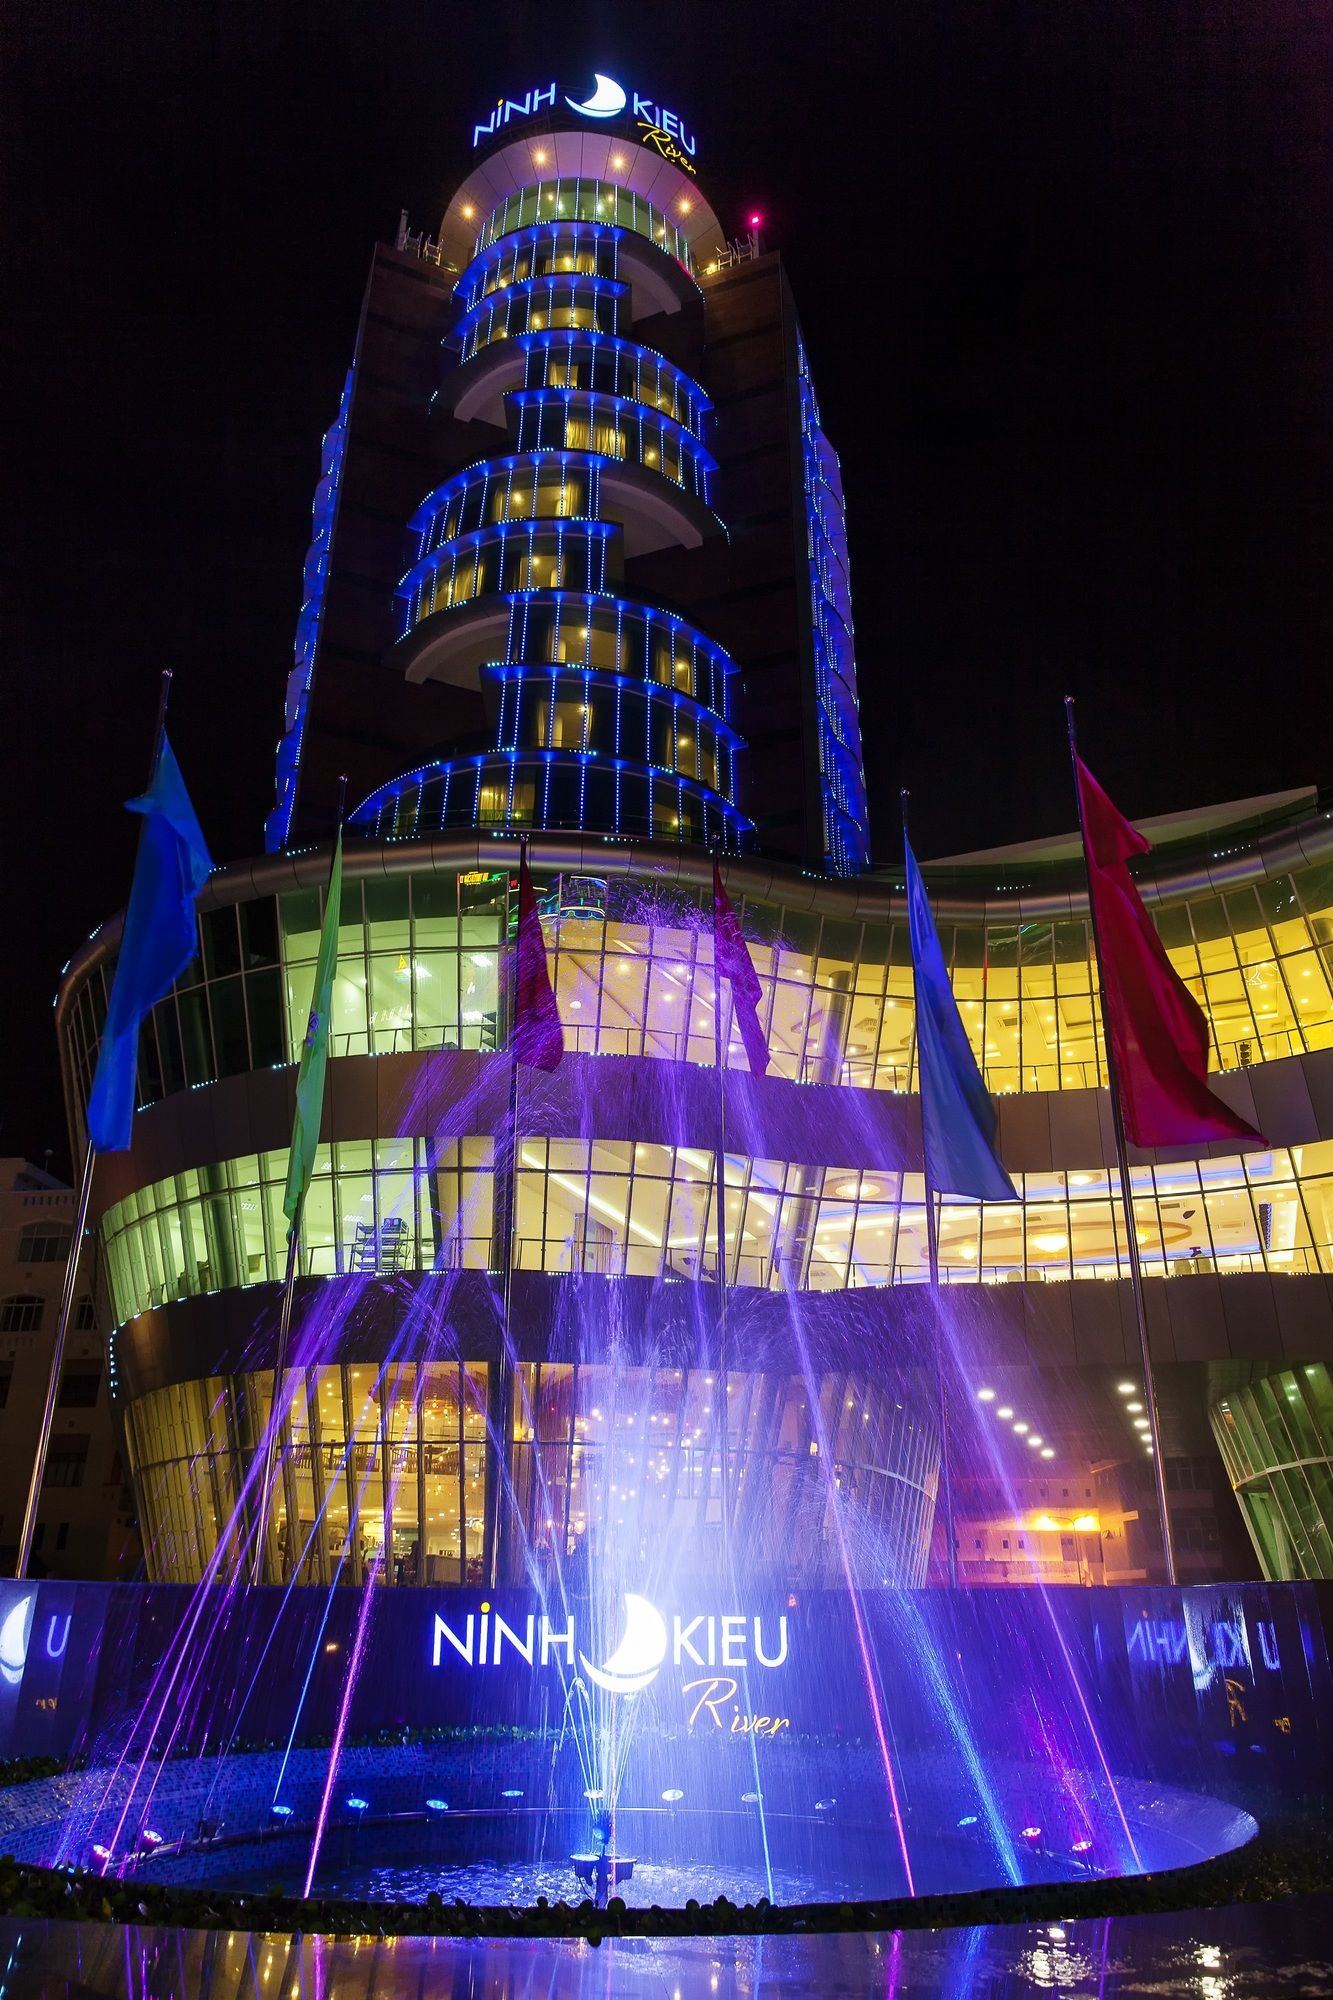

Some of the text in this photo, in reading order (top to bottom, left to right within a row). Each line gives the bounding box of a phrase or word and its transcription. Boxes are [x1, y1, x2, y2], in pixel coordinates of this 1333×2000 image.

[633, 92, 696, 156] KIEU
[637, 122, 697, 175] River
[674, 1615, 788, 1668] KIEU
[682, 1677, 790, 1735] River
